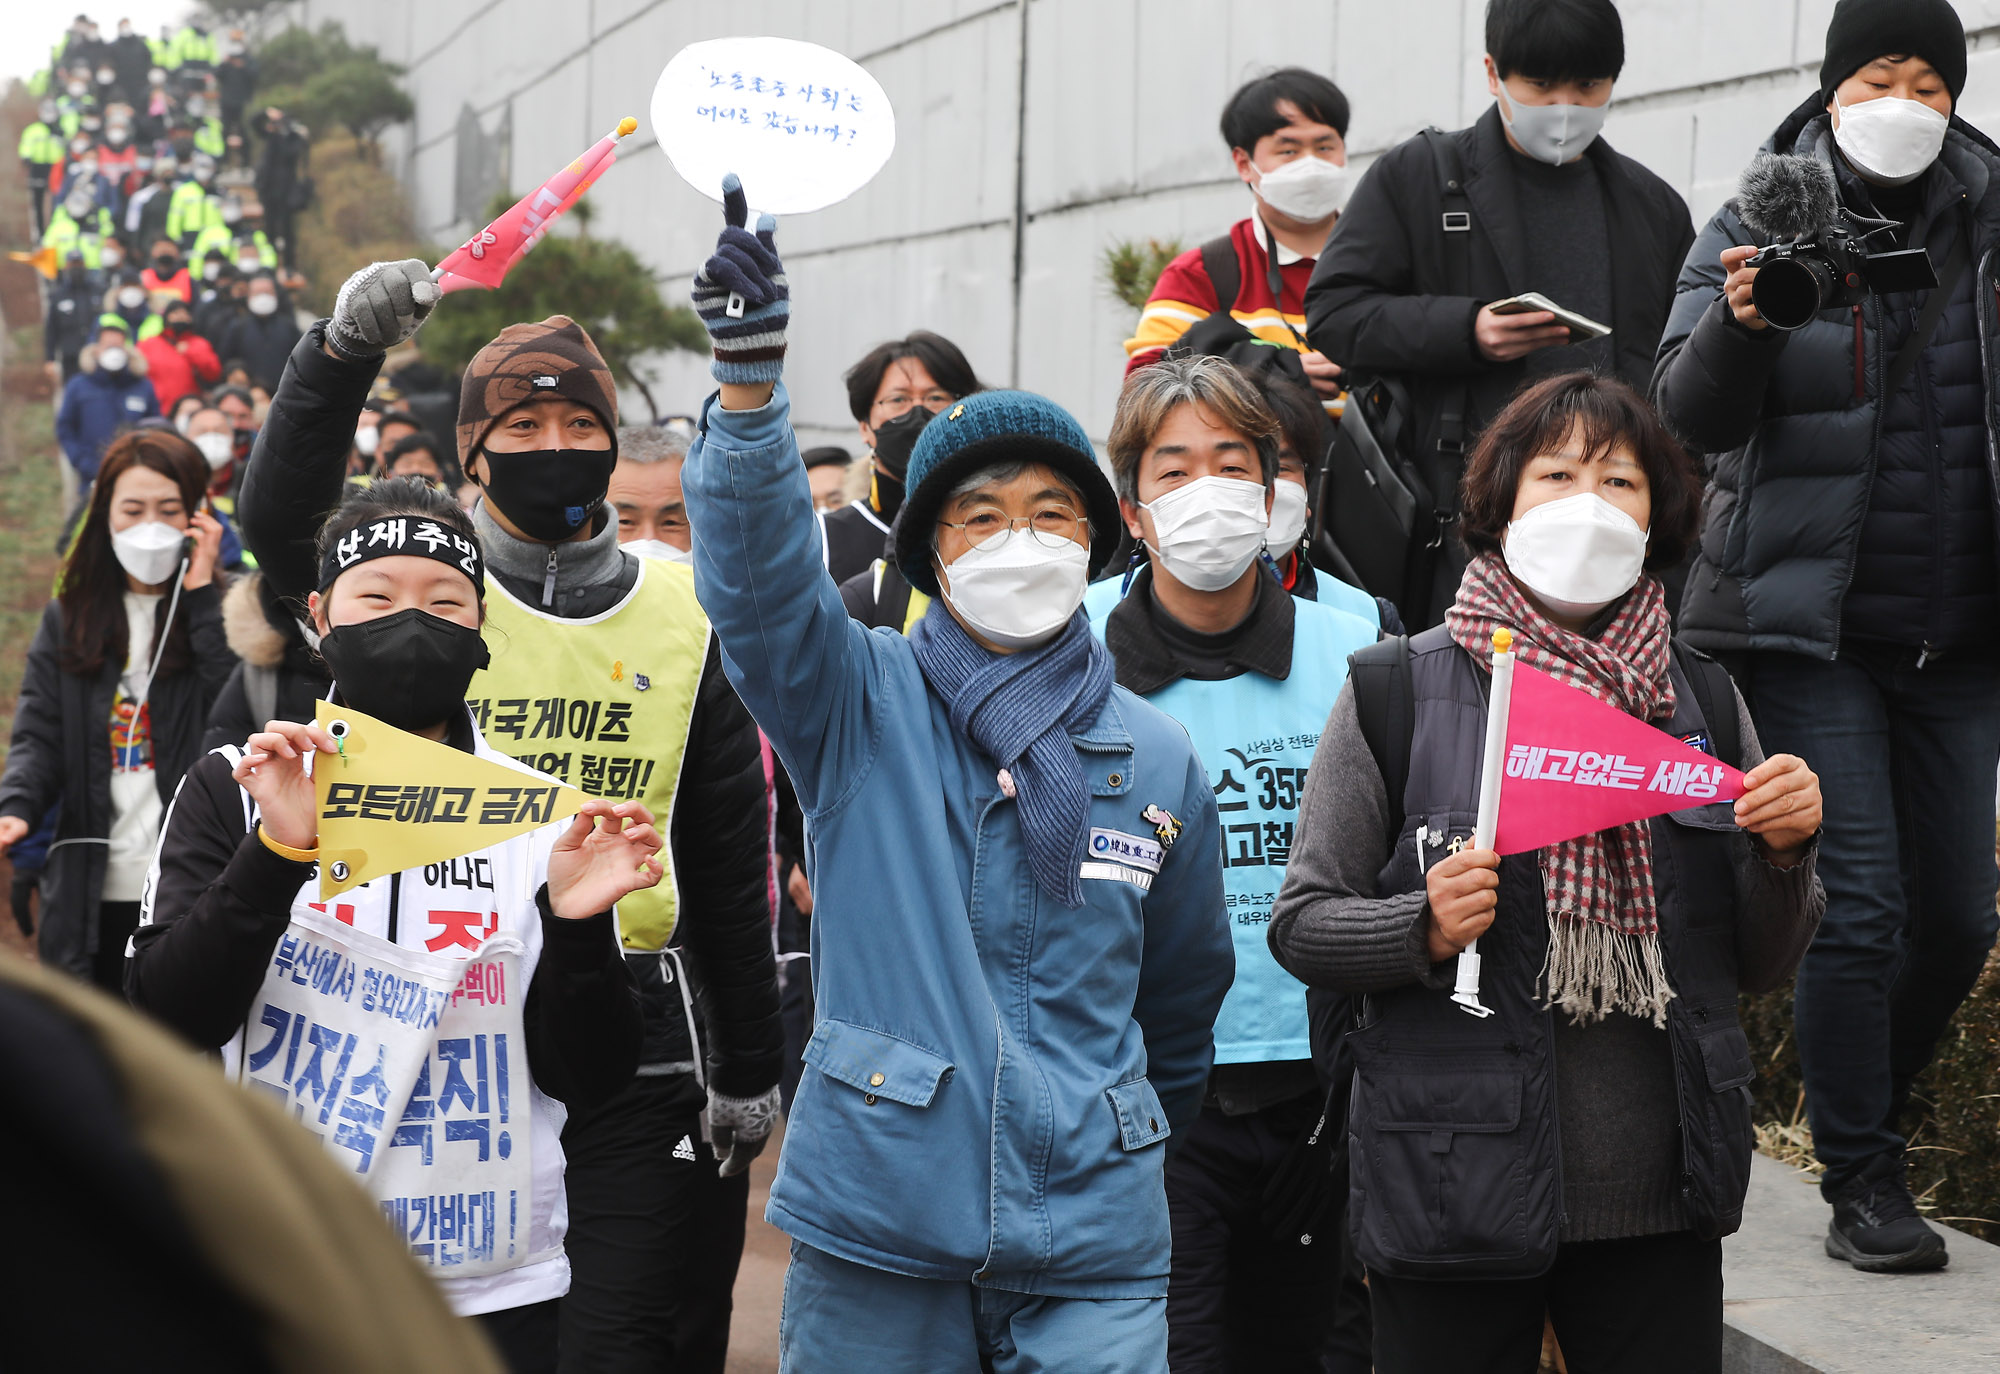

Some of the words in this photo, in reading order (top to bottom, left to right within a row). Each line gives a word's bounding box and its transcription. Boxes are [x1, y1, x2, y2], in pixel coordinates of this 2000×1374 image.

[1246, 737, 1285, 755] 사실상
[580, 754, 656, 800] 철회!
[1505, 744, 1646, 791] 해고없는
[1646, 759, 1725, 799] 세상
[322, 783, 475, 825] 모든해고
[479, 786, 560, 825] 금지
[274, 933, 355, 1004] 부산에서
